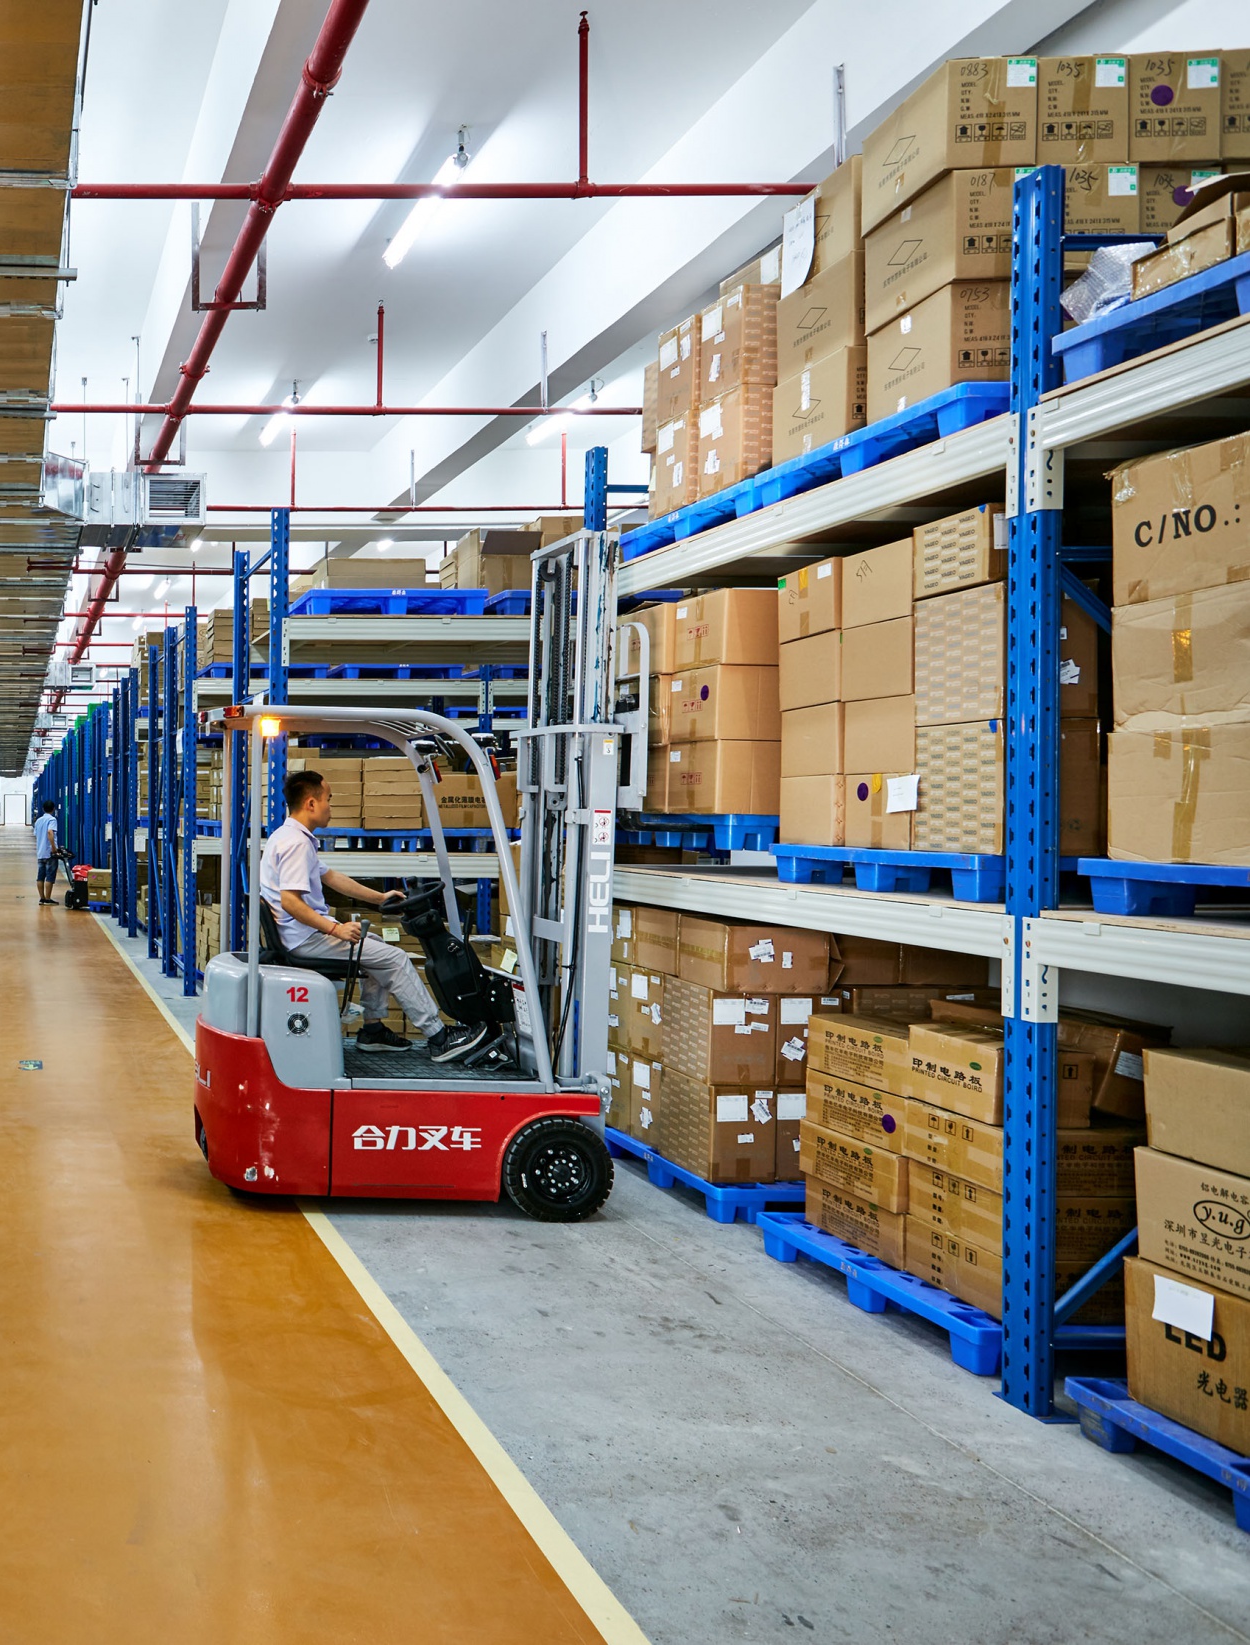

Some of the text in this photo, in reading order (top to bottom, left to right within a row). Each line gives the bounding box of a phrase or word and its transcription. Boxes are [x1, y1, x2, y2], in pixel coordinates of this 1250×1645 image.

[960, 63, 989, 81] 0883
[1056, 60, 1085, 78] 1035
[1145, 58, 1175, 76] 1035
[970, 172, 996, 195] 0187
[1069, 167, 1099, 191] 1035
[960, 287, 990, 303] 0753
[959, 514, 975, 523] YAGEO
[1134, 504, 1241, 548] C/NO.:
[924, 526, 939, 534] YAGEO
[941, 527, 956, 536] YAGEO
[959, 529, 975, 537] YAGEO
[924, 540, 939, 548] YAGEO
[941, 541, 956, 550] YAGEO
[959, 543, 975, 552] YAGEO
[924, 554, 939, 562] YAGEO
[941, 555, 956, 564] YAGEO
[959, 558, 975, 566] YAGEO
[924, 568, 939, 576] YAGEO
[941, 570, 956, 578] YAGEO
[959, 572, 975, 580] YAGEO
[924, 581, 939, 589] YAGEO
[588, 851, 611, 933] HELI
[286, 986, 309, 1003] 12
[825, 1030, 883, 1053] 印制电路板
[825, 1038, 846, 1048] PRINTED
[846, 1043, 866, 1053] CIRCUIT
[911, 1065, 936, 1079] PRINTED
[937, 1074, 961, 1086] CIRCUIT
[912, 1057, 982, 1087] 印制电路板
[824, 1084, 883, 1110] 印制电路板
[824, 1092, 844, 1103] PRINTED
[845, 1099, 866, 1110] CIRCUIT
[351, 1125, 482, 1150] 合力叉车
[817, 1136, 873, 1166] 印制电路板
[822, 1188, 879, 1222] 印制电路板
[1199, 1206, 1245, 1235] y.u.g
[1164, 1219, 1250, 1259] 深圳市昱光电子
[1197, 1370, 1249, 1411] 光电器
